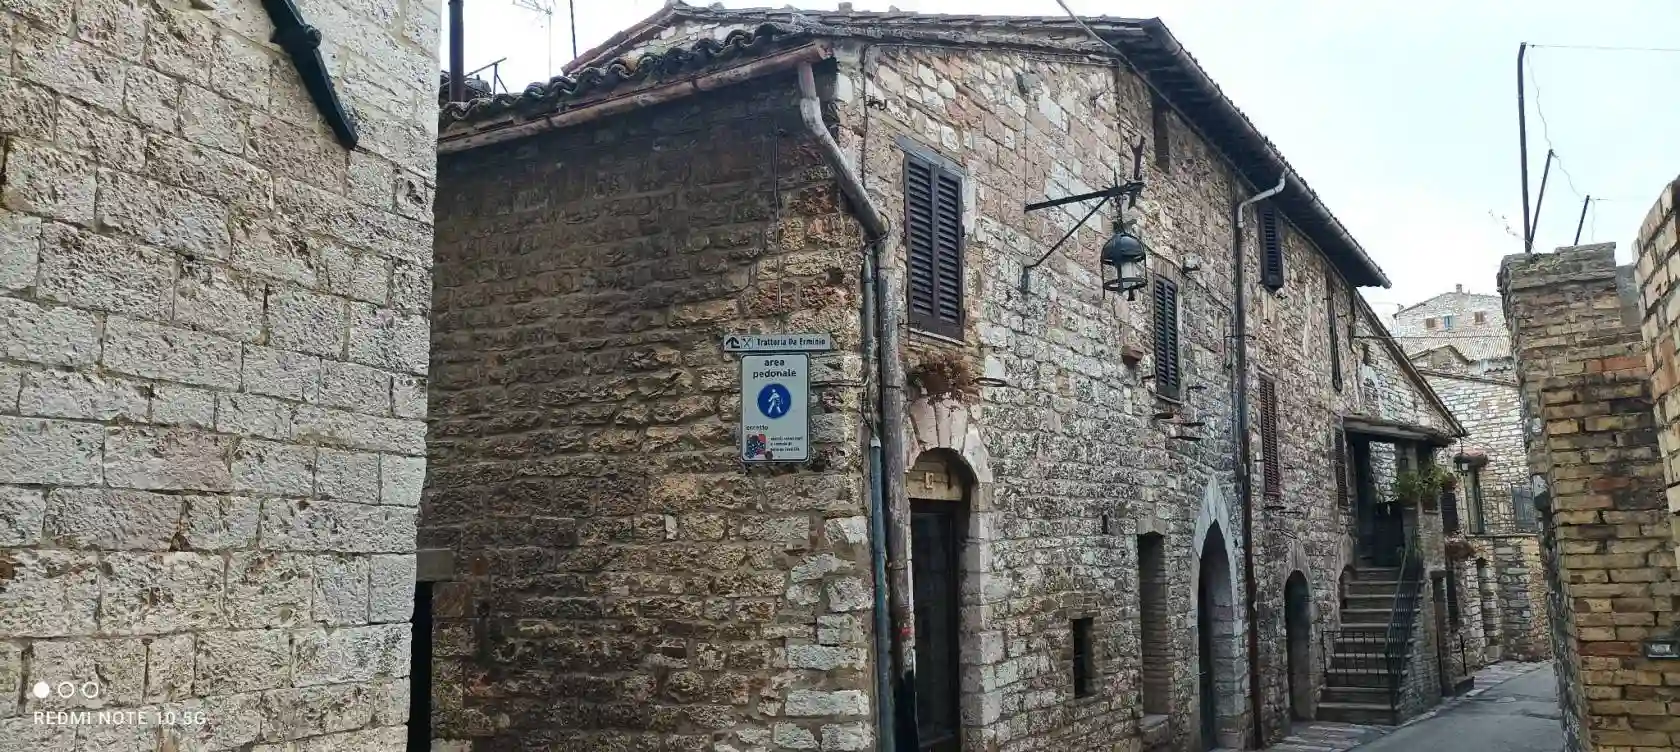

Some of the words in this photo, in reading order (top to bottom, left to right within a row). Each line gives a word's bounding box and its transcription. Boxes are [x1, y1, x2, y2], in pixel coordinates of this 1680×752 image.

[756, 338, 787, 346] Trattoria
[799, 337, 826, 345] Erminio
[752, 369, 797, 379] pedonale
